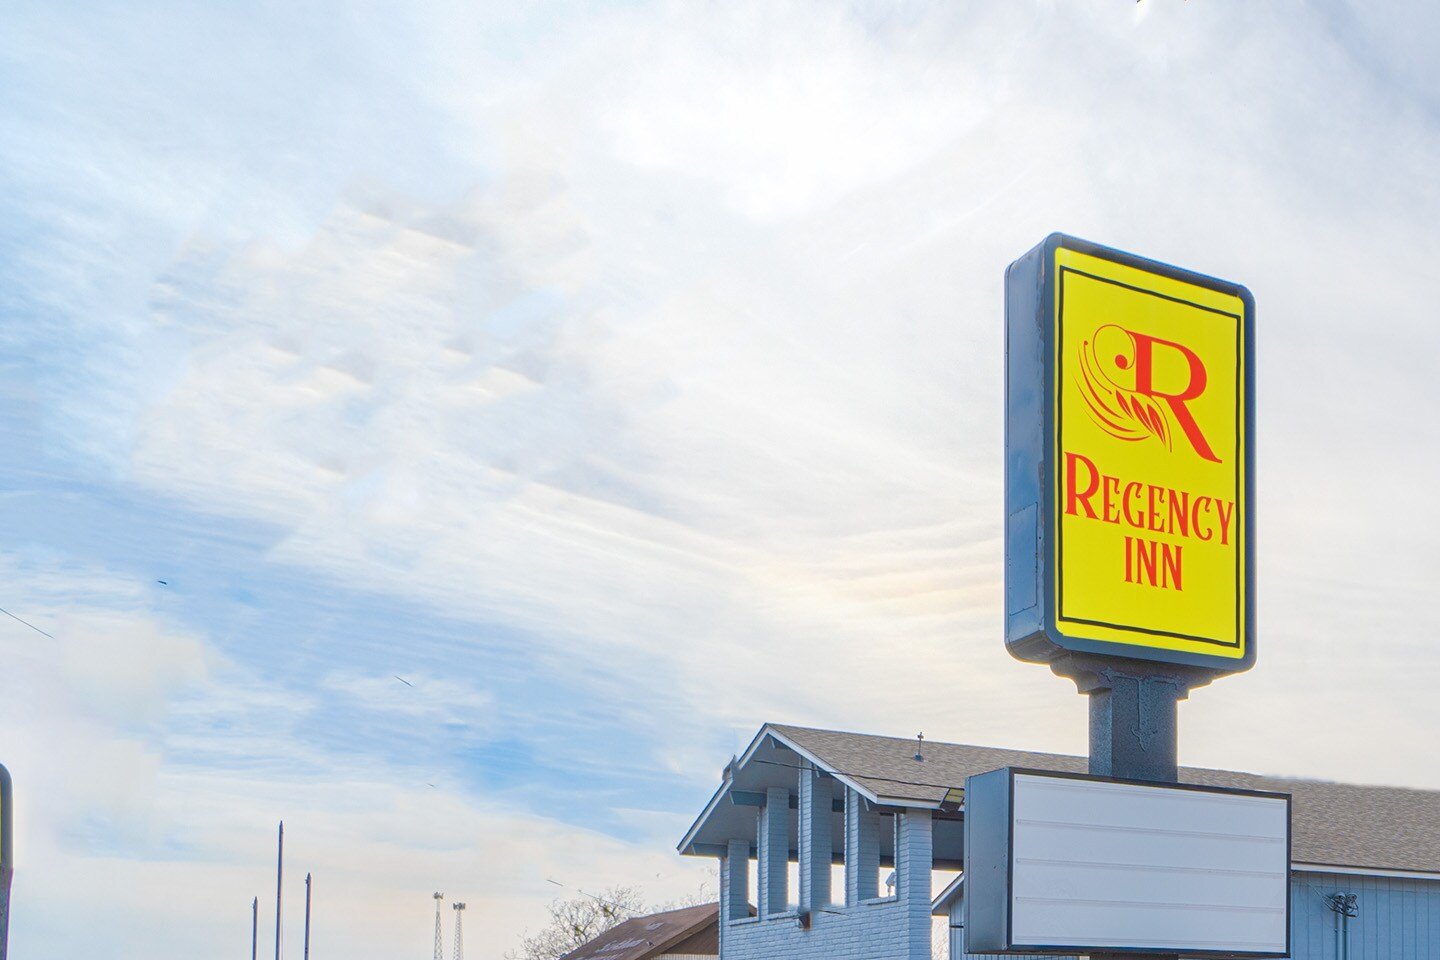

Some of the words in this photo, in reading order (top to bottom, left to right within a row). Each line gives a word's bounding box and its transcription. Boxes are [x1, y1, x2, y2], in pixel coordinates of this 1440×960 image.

[1093, 324, 1223, 464] R
[1064, 451, 1235, 546] REGENCY
[1124, 535, 1184, 592] INN
